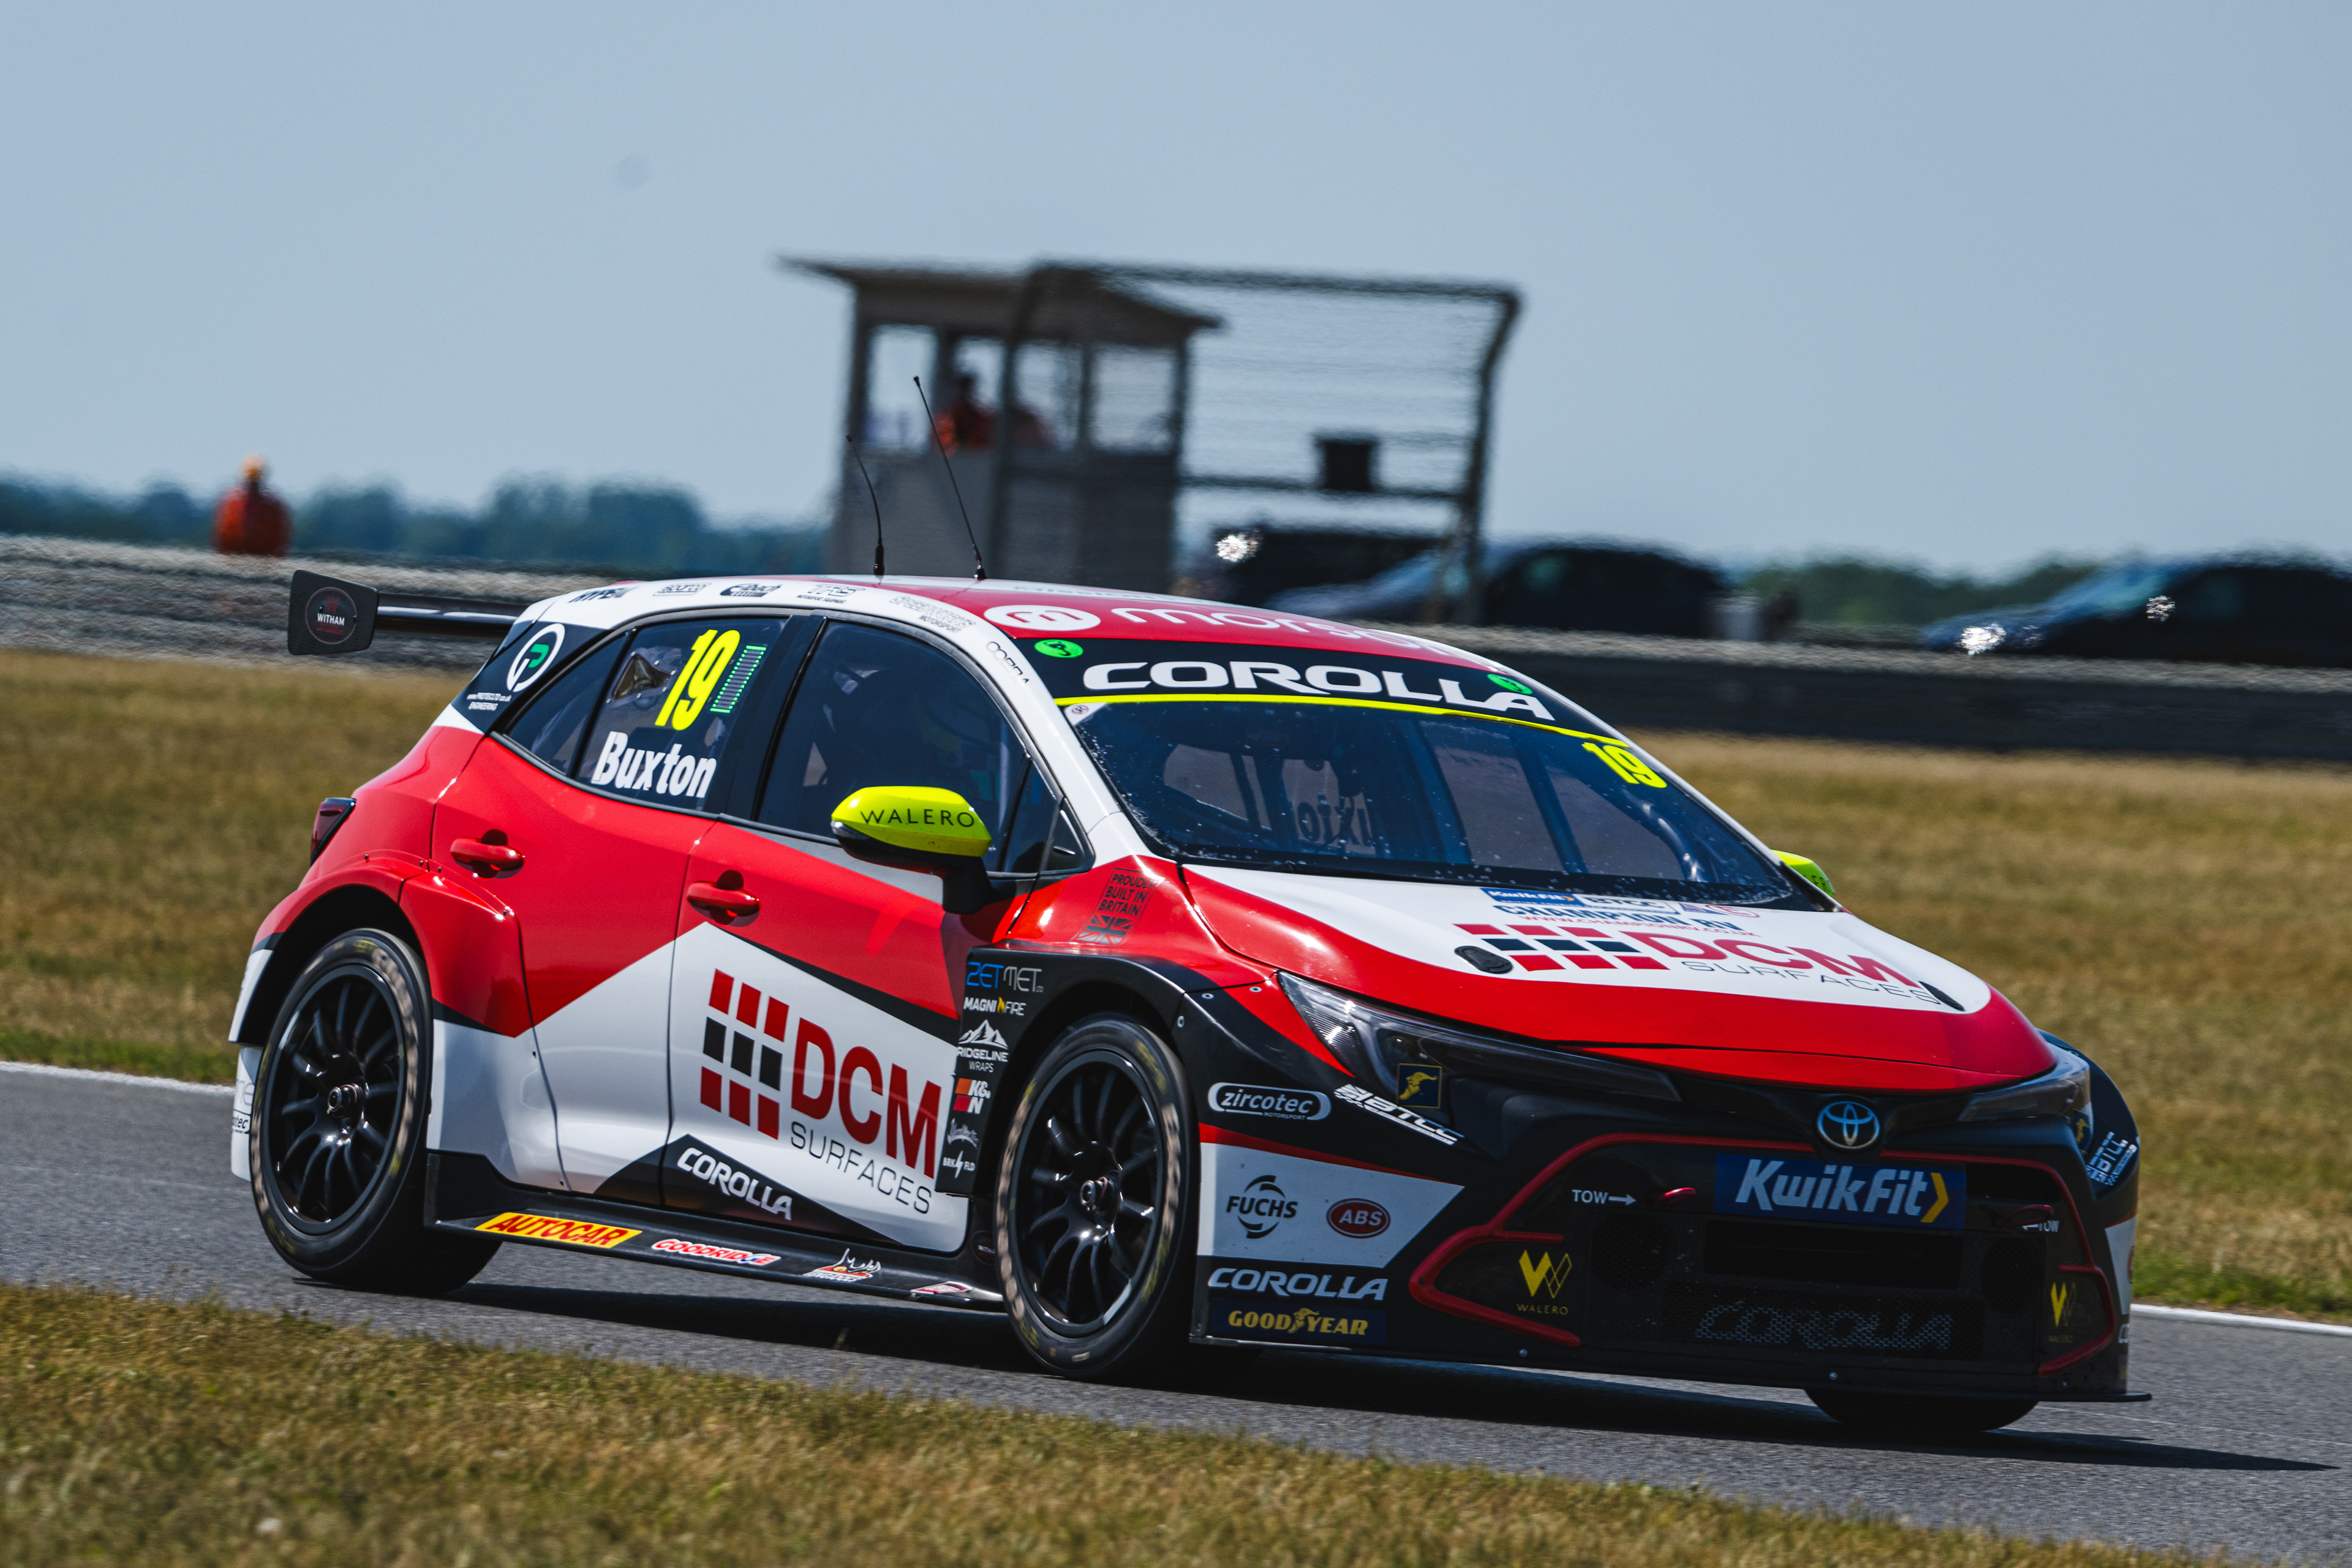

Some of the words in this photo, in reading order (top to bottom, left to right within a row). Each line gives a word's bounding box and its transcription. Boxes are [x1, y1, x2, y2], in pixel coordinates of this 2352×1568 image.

[807, 584, 865, 597] TRS
[317, 612, 345, 626] WITHAM
[655, 629, 741, 731] 19
[1082, 660, 1556, 722] COROLLA
[591, 730, 717, 798] Buxton
[1582, 740, 1667, 789] 19
[860, 808, 975, 827] WALERO
[1111, 873, 1155, 889] PROUDLY
[1098, 899, 1142, 916] BRITAIN
[1105, 886, 1135, 901] BUILT
[1133, 890, 1148, 903] IN
[1493, 905, 1692, 925] CHAMPION
[1689, 918, 1744, 931] RV
[1620, 930, 1923, 988] DCM
[1681, 959, 1942, 1006] SURFACES
[957, 1046, 1008, 1063] RIDGELINE
[969, 1060, 994, 1073] WRAPS
[791, 1017, 942, 1180] DCM
[1221, 1088, 1314, 1114] zircotec
[791, 1121, 933, 1215] SURFACES
[677, 1147, 793, 1221] COROLLA
[1572, 1189, 1608, 1205] TOW
[1226, 1195, 1298, 1219] FUCHS
[1338, 1208, 1383, 1227] ABS
[484, 1214, 629, 1246] AUTOCAR
[654, 1239, 779, 1265] GOODRIDGE
[1208, 1267, 1389, 1300] COROLLA
[1227, 1307, 1369, 1336] GOODYEAR
[1516, 1302, 1569, 1315] WALERO
[1695, 1305, 1953, 1350] COROLLA
